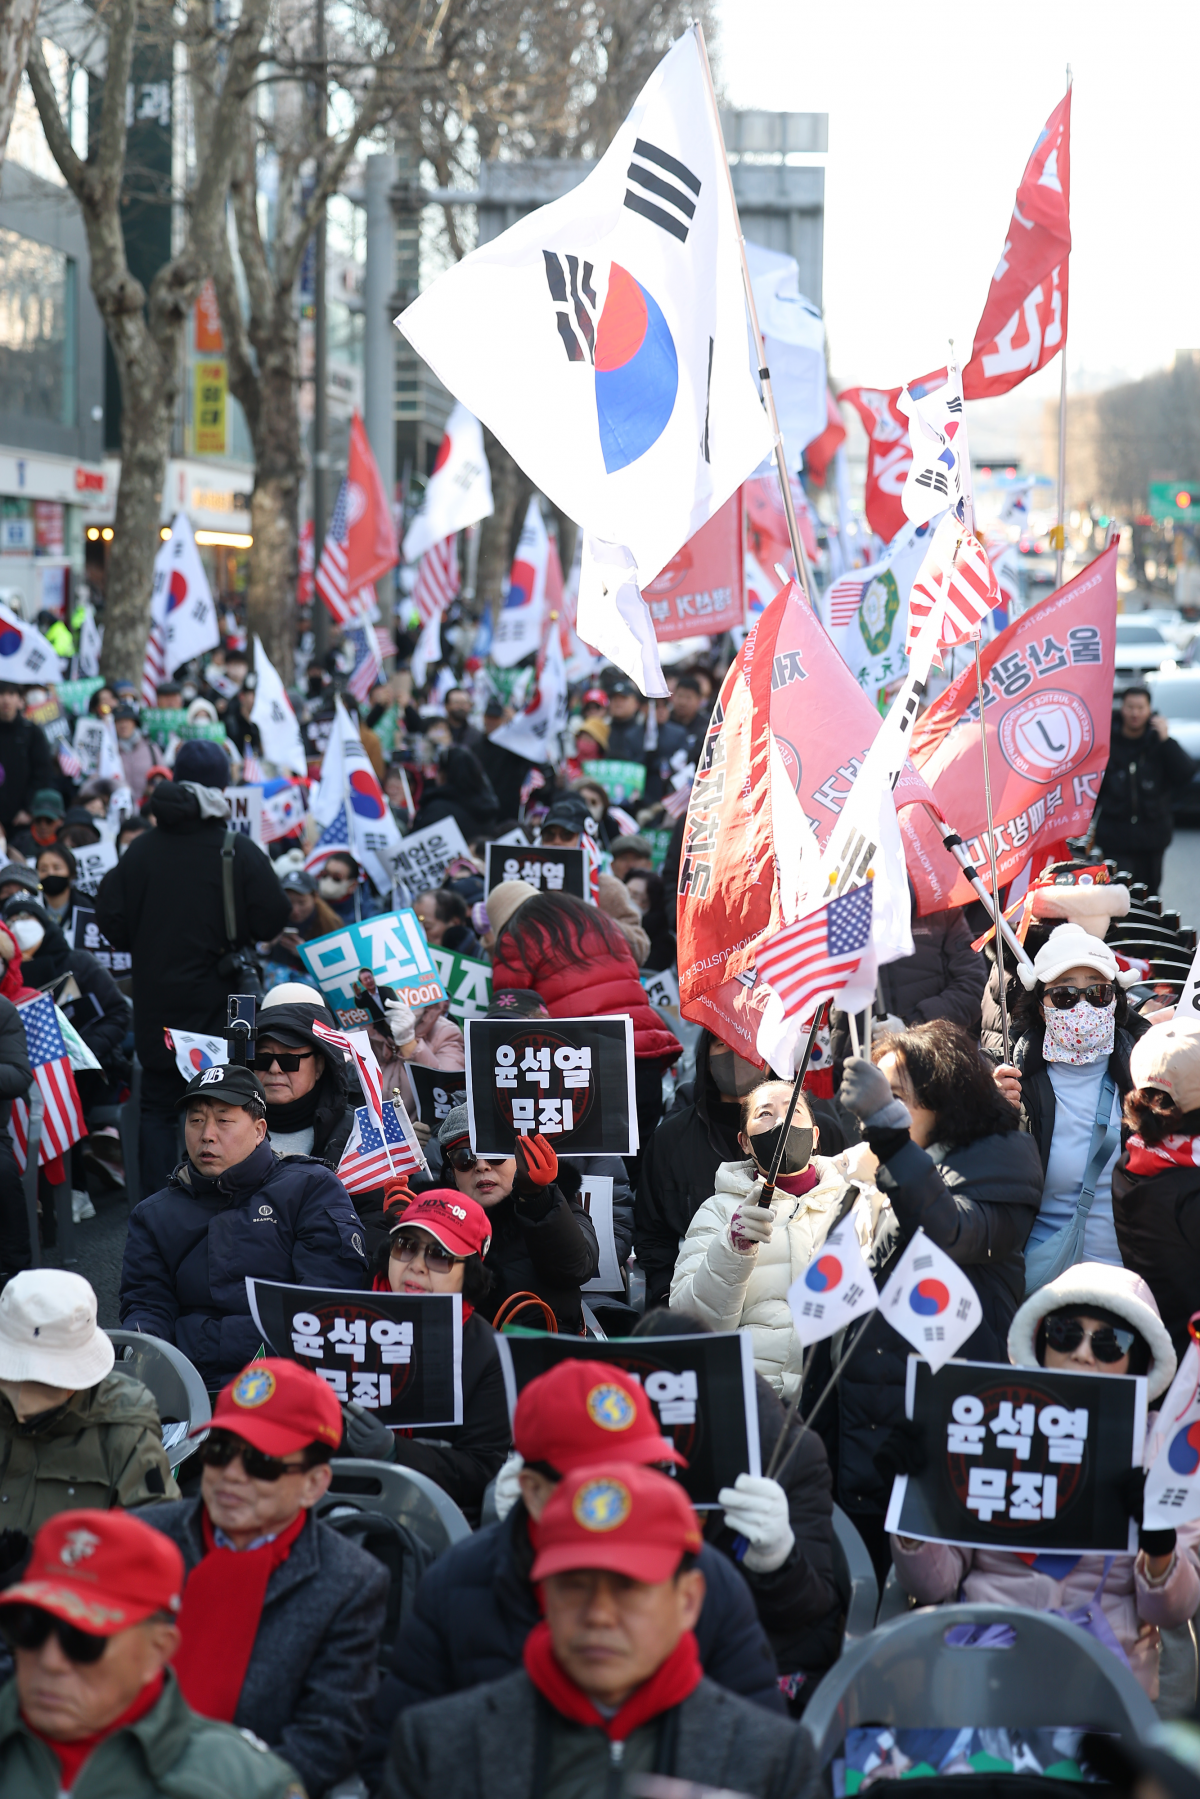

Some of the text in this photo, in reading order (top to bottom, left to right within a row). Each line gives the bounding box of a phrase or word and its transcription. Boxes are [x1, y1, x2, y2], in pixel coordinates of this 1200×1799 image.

[336, 982, 443, 1028] Free Yoon
[494, 1044, 592, 1089] 윤석열
[511, 1098, 574, 1136] 무죄
[291, 1312, 414, 1364] 윤석열
[315, 1367, 392, 1409] 무죄
[946, 1395, 1089, 1465] 윤석열
[966, 1467, 1058, 1522] 무죄
